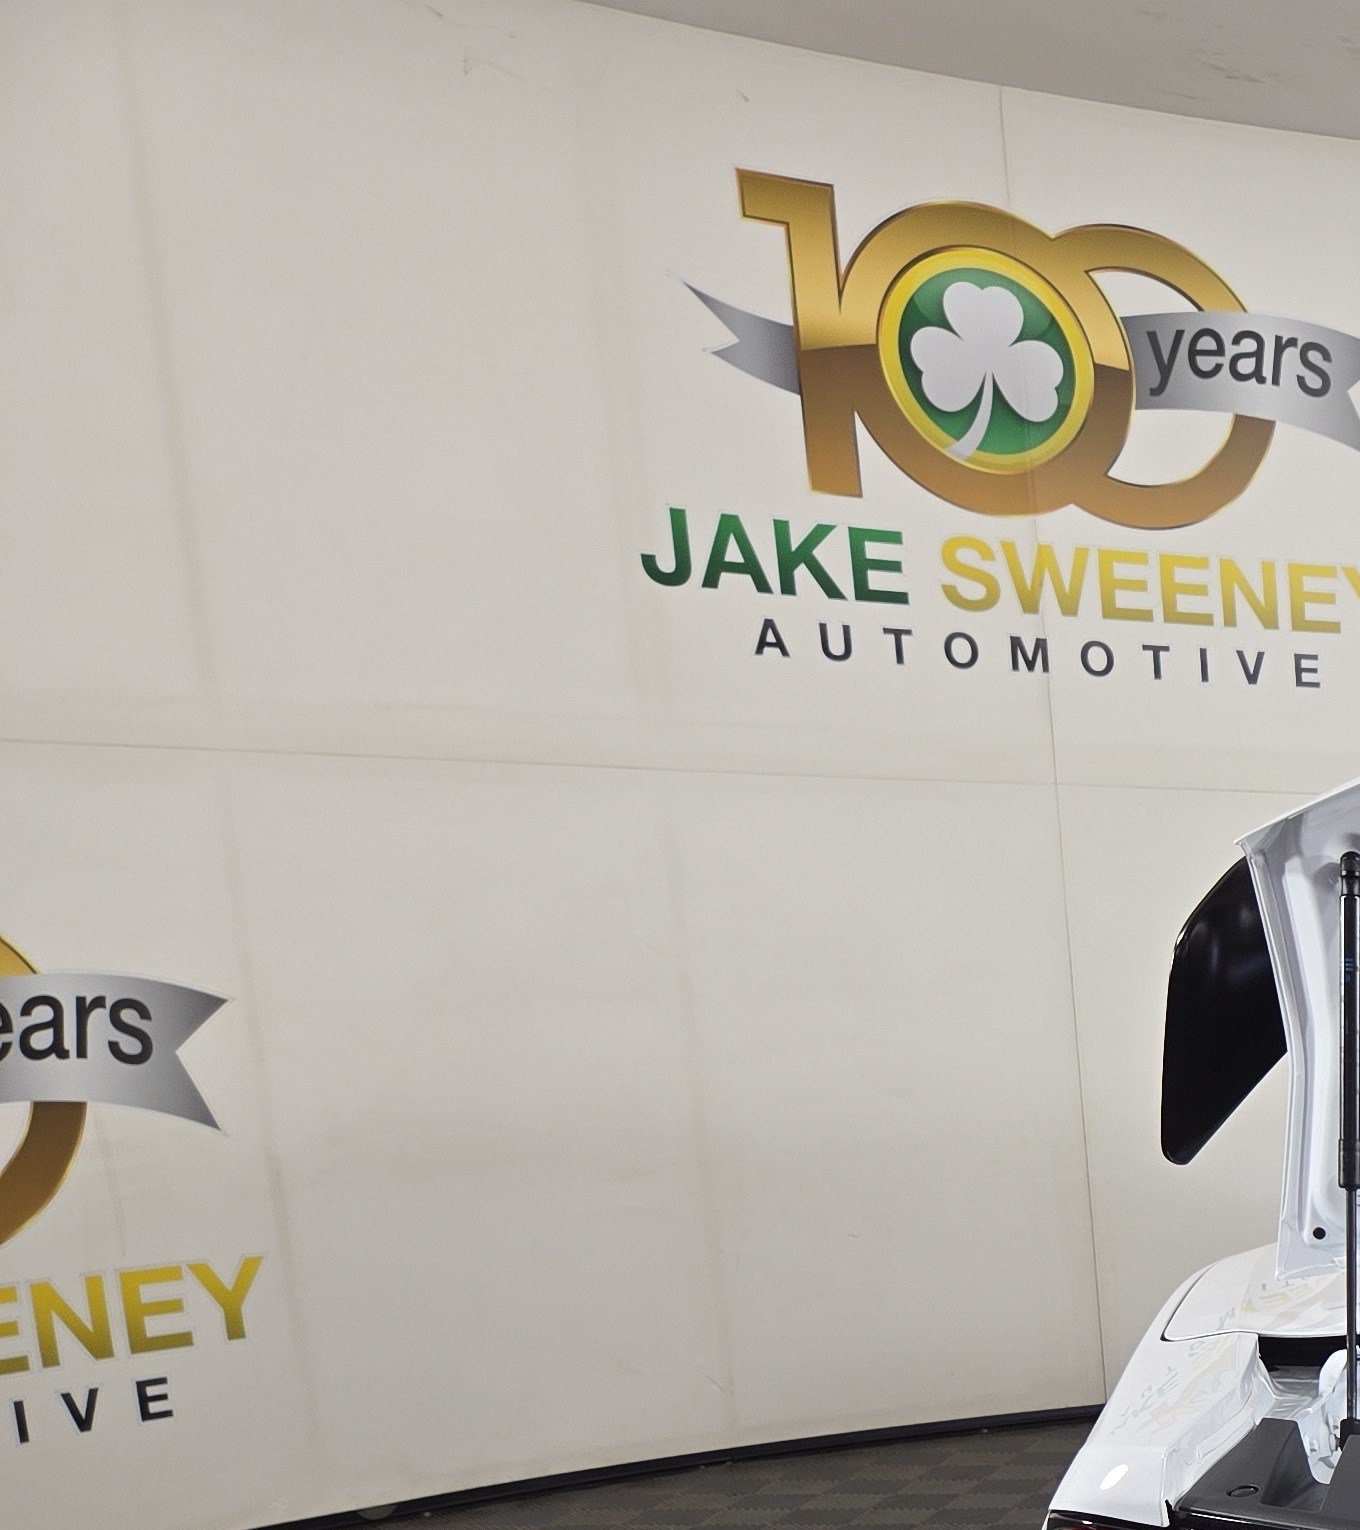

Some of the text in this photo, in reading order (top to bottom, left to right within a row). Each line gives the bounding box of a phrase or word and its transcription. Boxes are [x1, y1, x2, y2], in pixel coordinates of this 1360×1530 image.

[1146, 323, 1334, 400] years
[640, 508, 911, 605] JAKE
[754, 618, 1323, 690] AUTOMOTIVE
[0, 994, 154, 1066] ars
[13, 1376, 174, 1444] IVE
